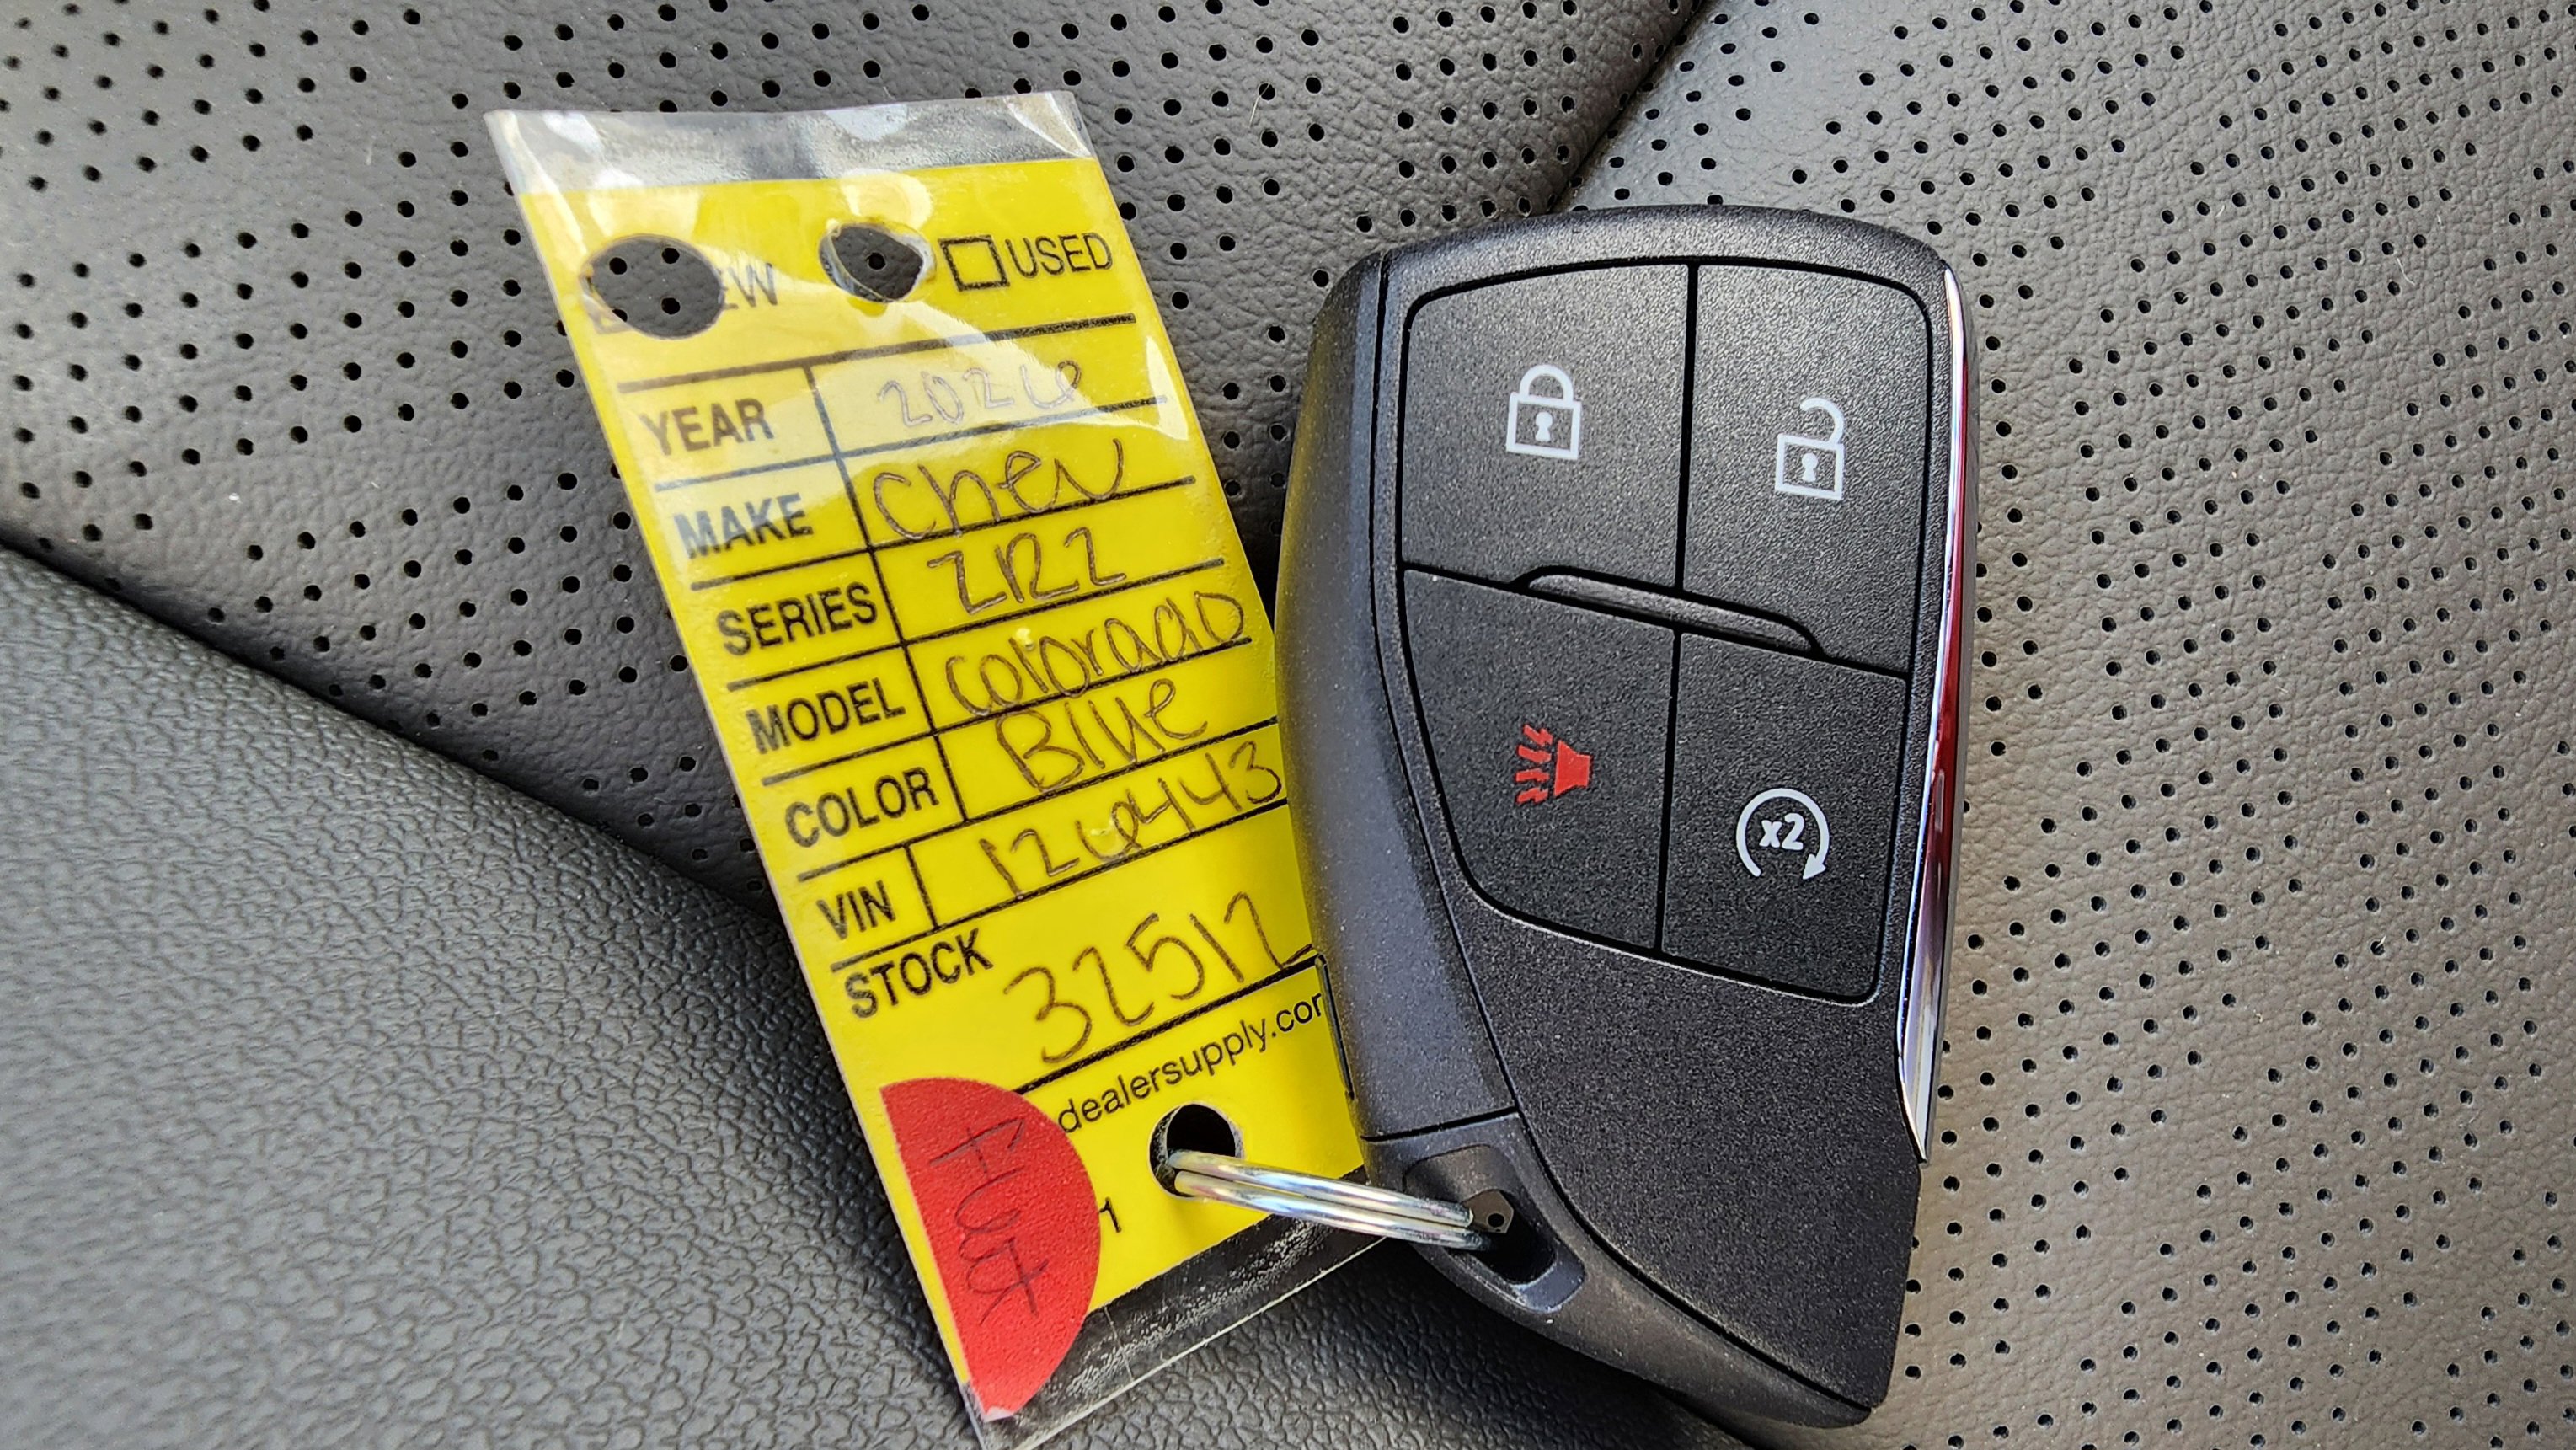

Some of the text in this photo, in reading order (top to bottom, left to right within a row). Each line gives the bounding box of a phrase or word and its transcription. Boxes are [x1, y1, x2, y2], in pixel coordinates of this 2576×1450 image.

[1004, 232, 1113, 279] USED
[639, 398, 775, 457] YEAR
[877, 360, 1082, 427] 2026
[674, 492, 814, 560] MAKE
[716, 581, 878, 656] SERIES
[746, 677, 906, 755] MODEL
[994, 677, 1226, 794] Blue
[784, 767, 940, 848] COLOR
[1759, 812, 1804, 851] x2
[816, 880, 896, 941] VIN
[844, 928, 994, 1019] STOCK
[1003, 891, 1313, 1064] 32512
